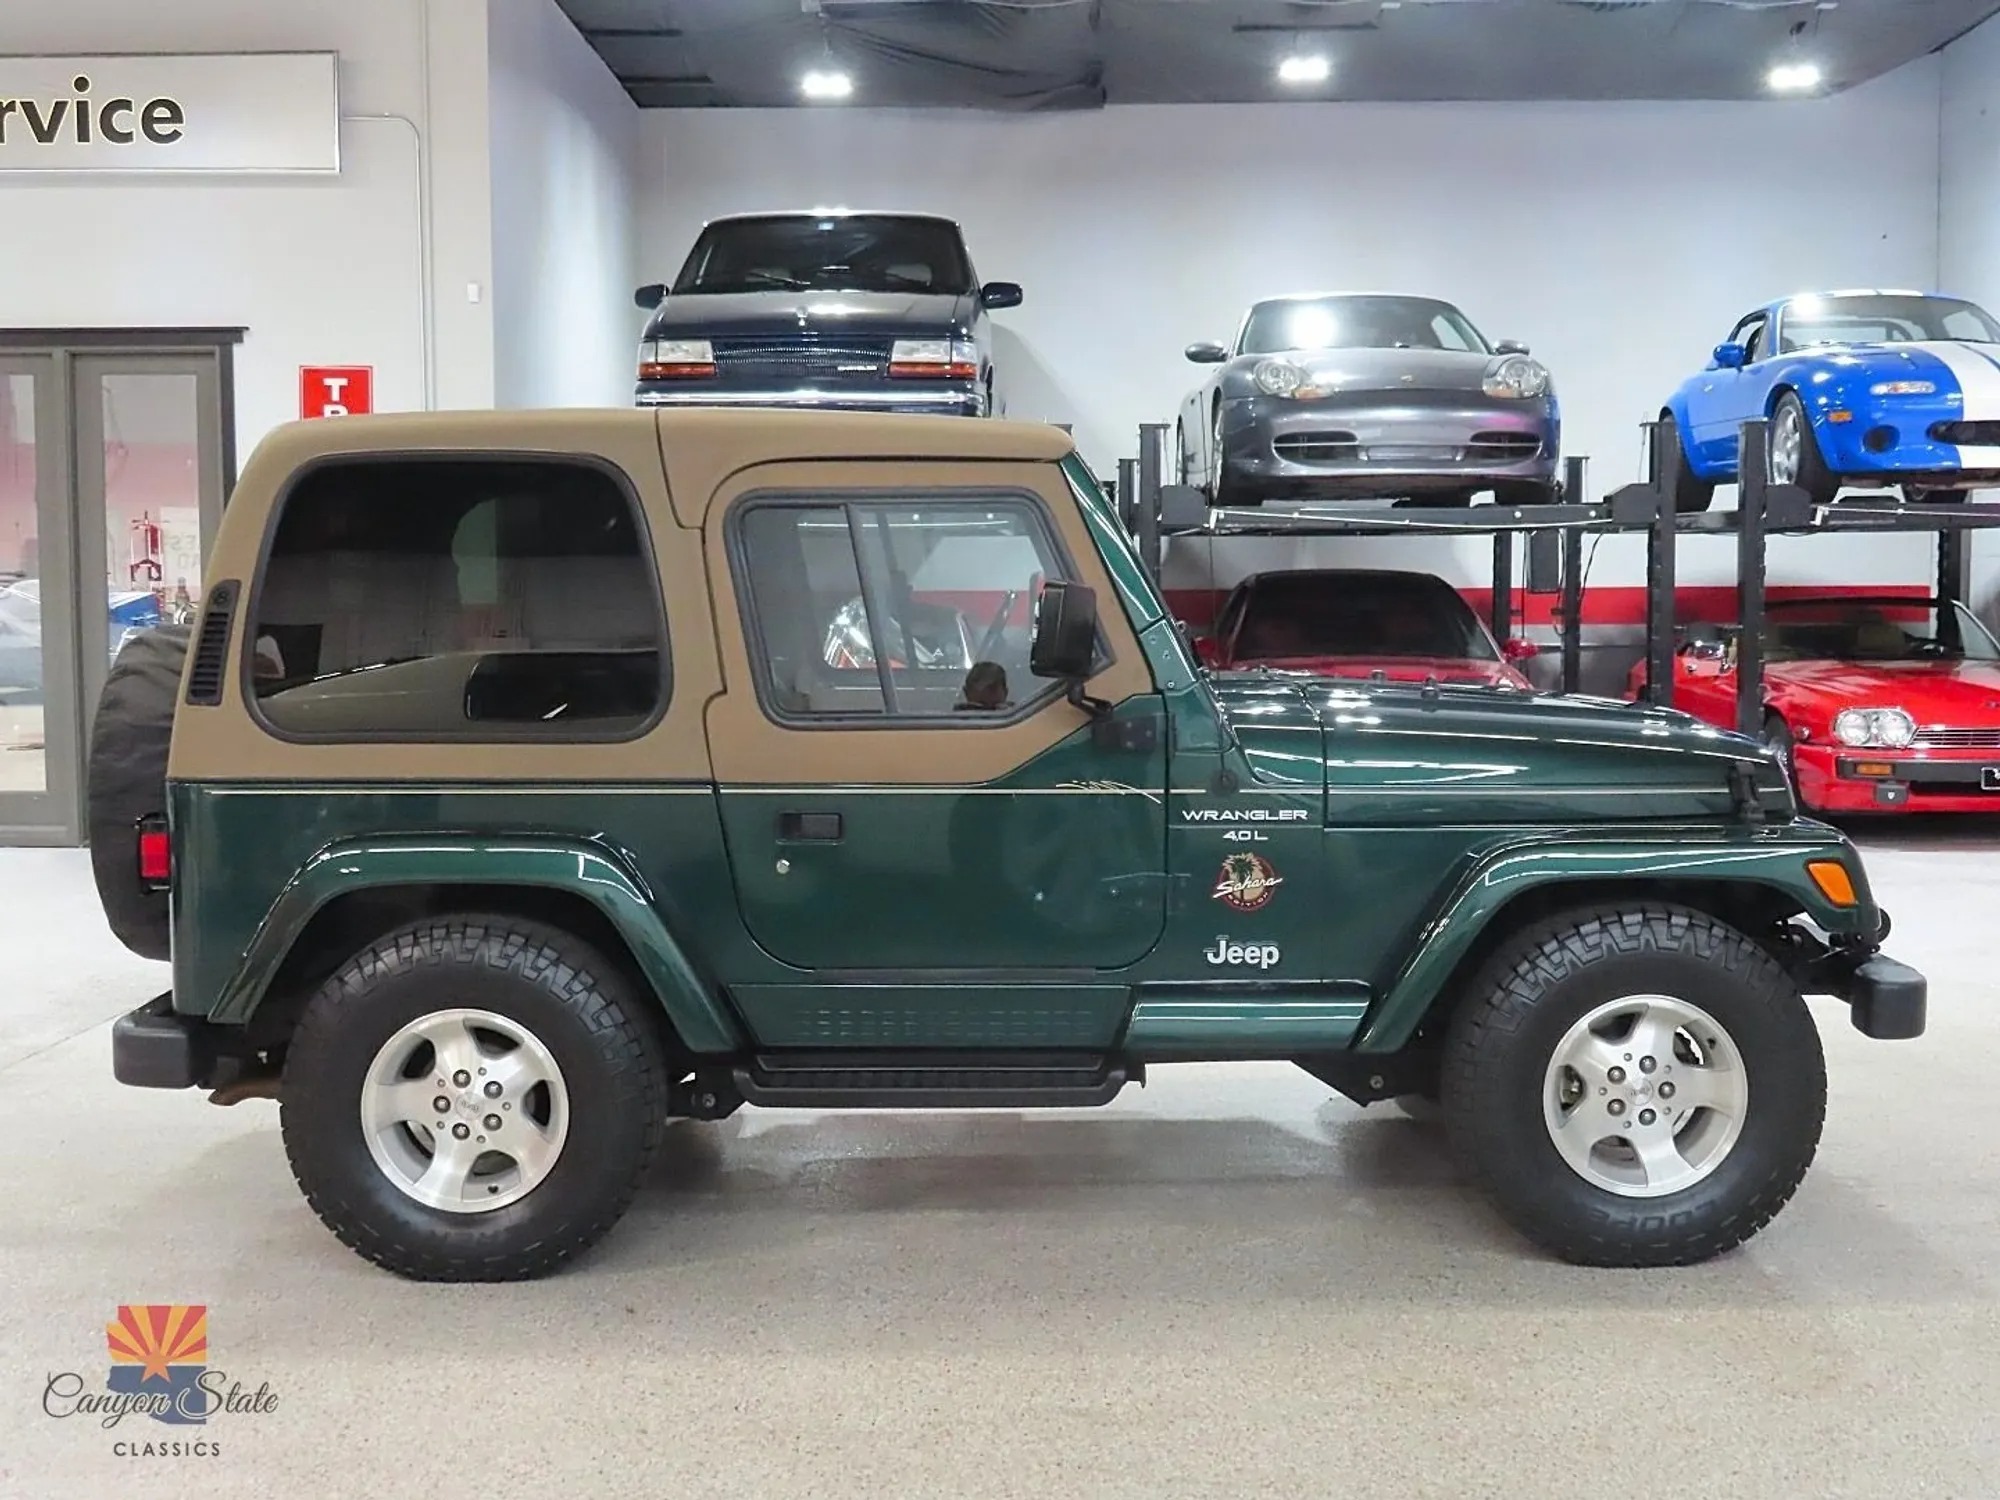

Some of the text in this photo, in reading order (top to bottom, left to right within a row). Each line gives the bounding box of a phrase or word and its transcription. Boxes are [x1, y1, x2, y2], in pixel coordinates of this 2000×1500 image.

[1182, 810, 1308, 821] WRANGLER
[1212, 874, 1284, 899] Sahara
[1204, 937, 1281, 970] Jeep
